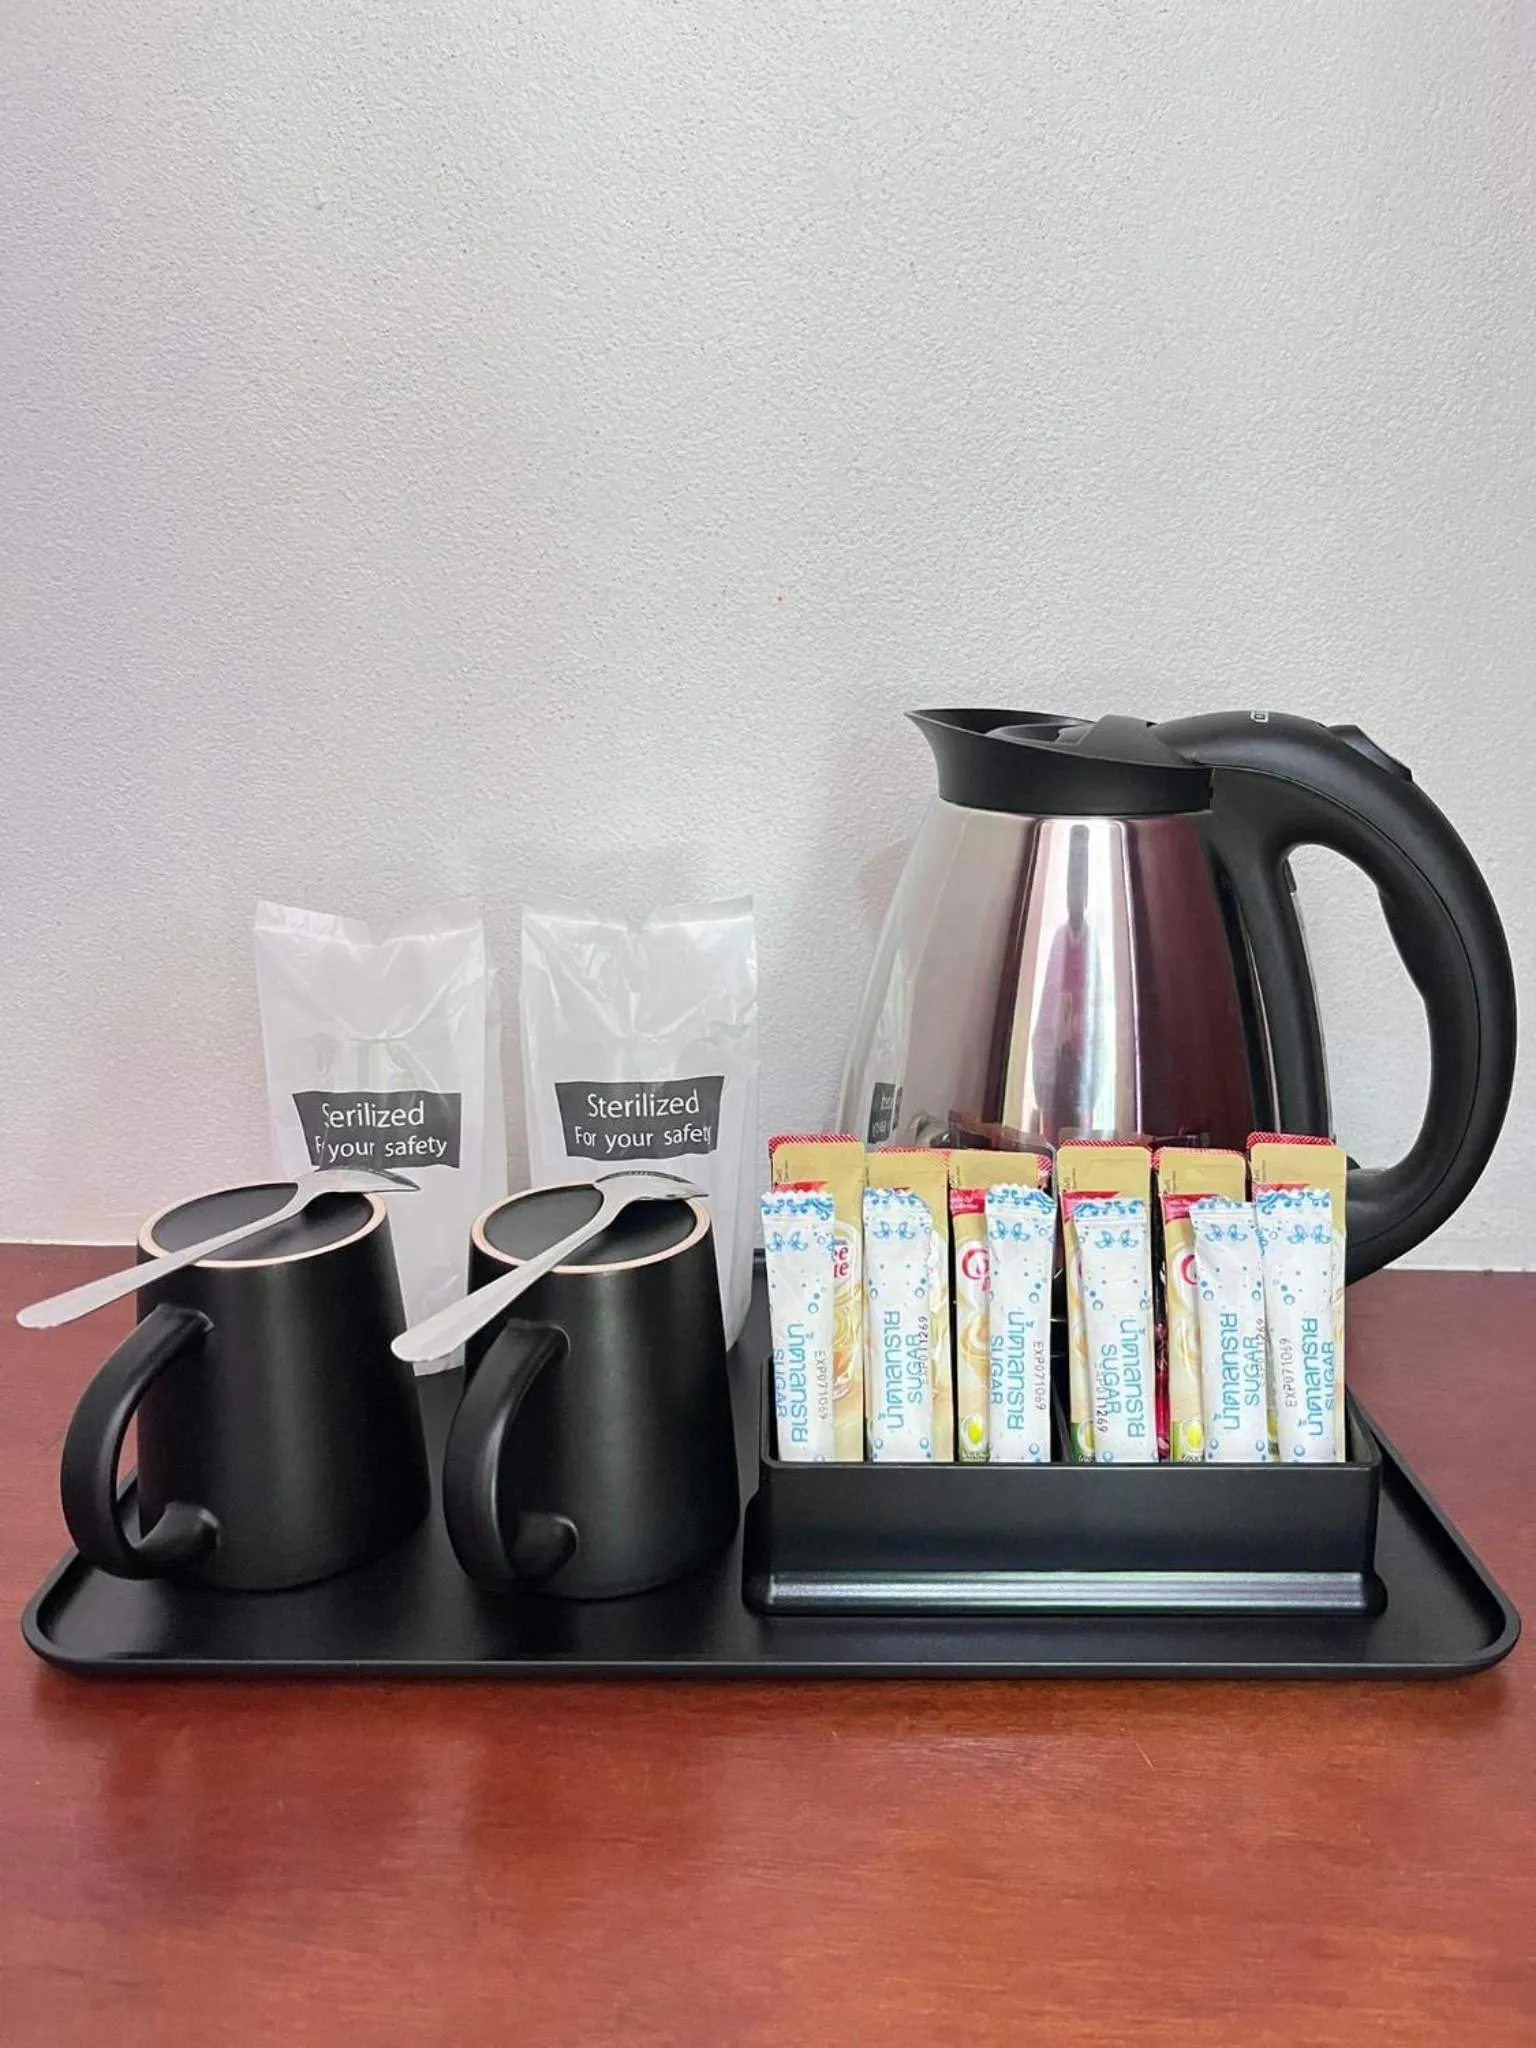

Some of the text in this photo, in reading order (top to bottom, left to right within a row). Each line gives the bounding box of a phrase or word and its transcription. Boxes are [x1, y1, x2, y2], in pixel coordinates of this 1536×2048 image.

[321, 1099, 425, 1128] Serilized
[586, 1087, 700, 1119] Sterilized
[327, 1140, 376, 1164] your
[384, 1134, 448, 1158] safety
[574, 1125, 597, 1147] For
[604, 1130, 654, 1155] your
[772, 1347, 787, 1419] SUGAR
[788, 1323, 815, 1443] น้ำตาลทราย
[877, 1310, 904, 1429] น้ำตาลทราย
[905, 1333, 924, 1404] SUGAR
[989, 1334, 1004, 1406] SUGAR
[1007, 1310, 1034, 1430] น้ำตาลทราย
[1101, 1343, 1122, 1416] SUGAR
[1120, 1318, 1146, 1438] น้ำตาลทราย
[1213, 1313, 1241, 1430] น้ำตาลทราย
[1243, 1335, 1261, 1407] SUGAR
[1295, 1317, 1324, 1437] น้ำตาลทราย
[1322, 1341, 1336, 1411] SUGAR
